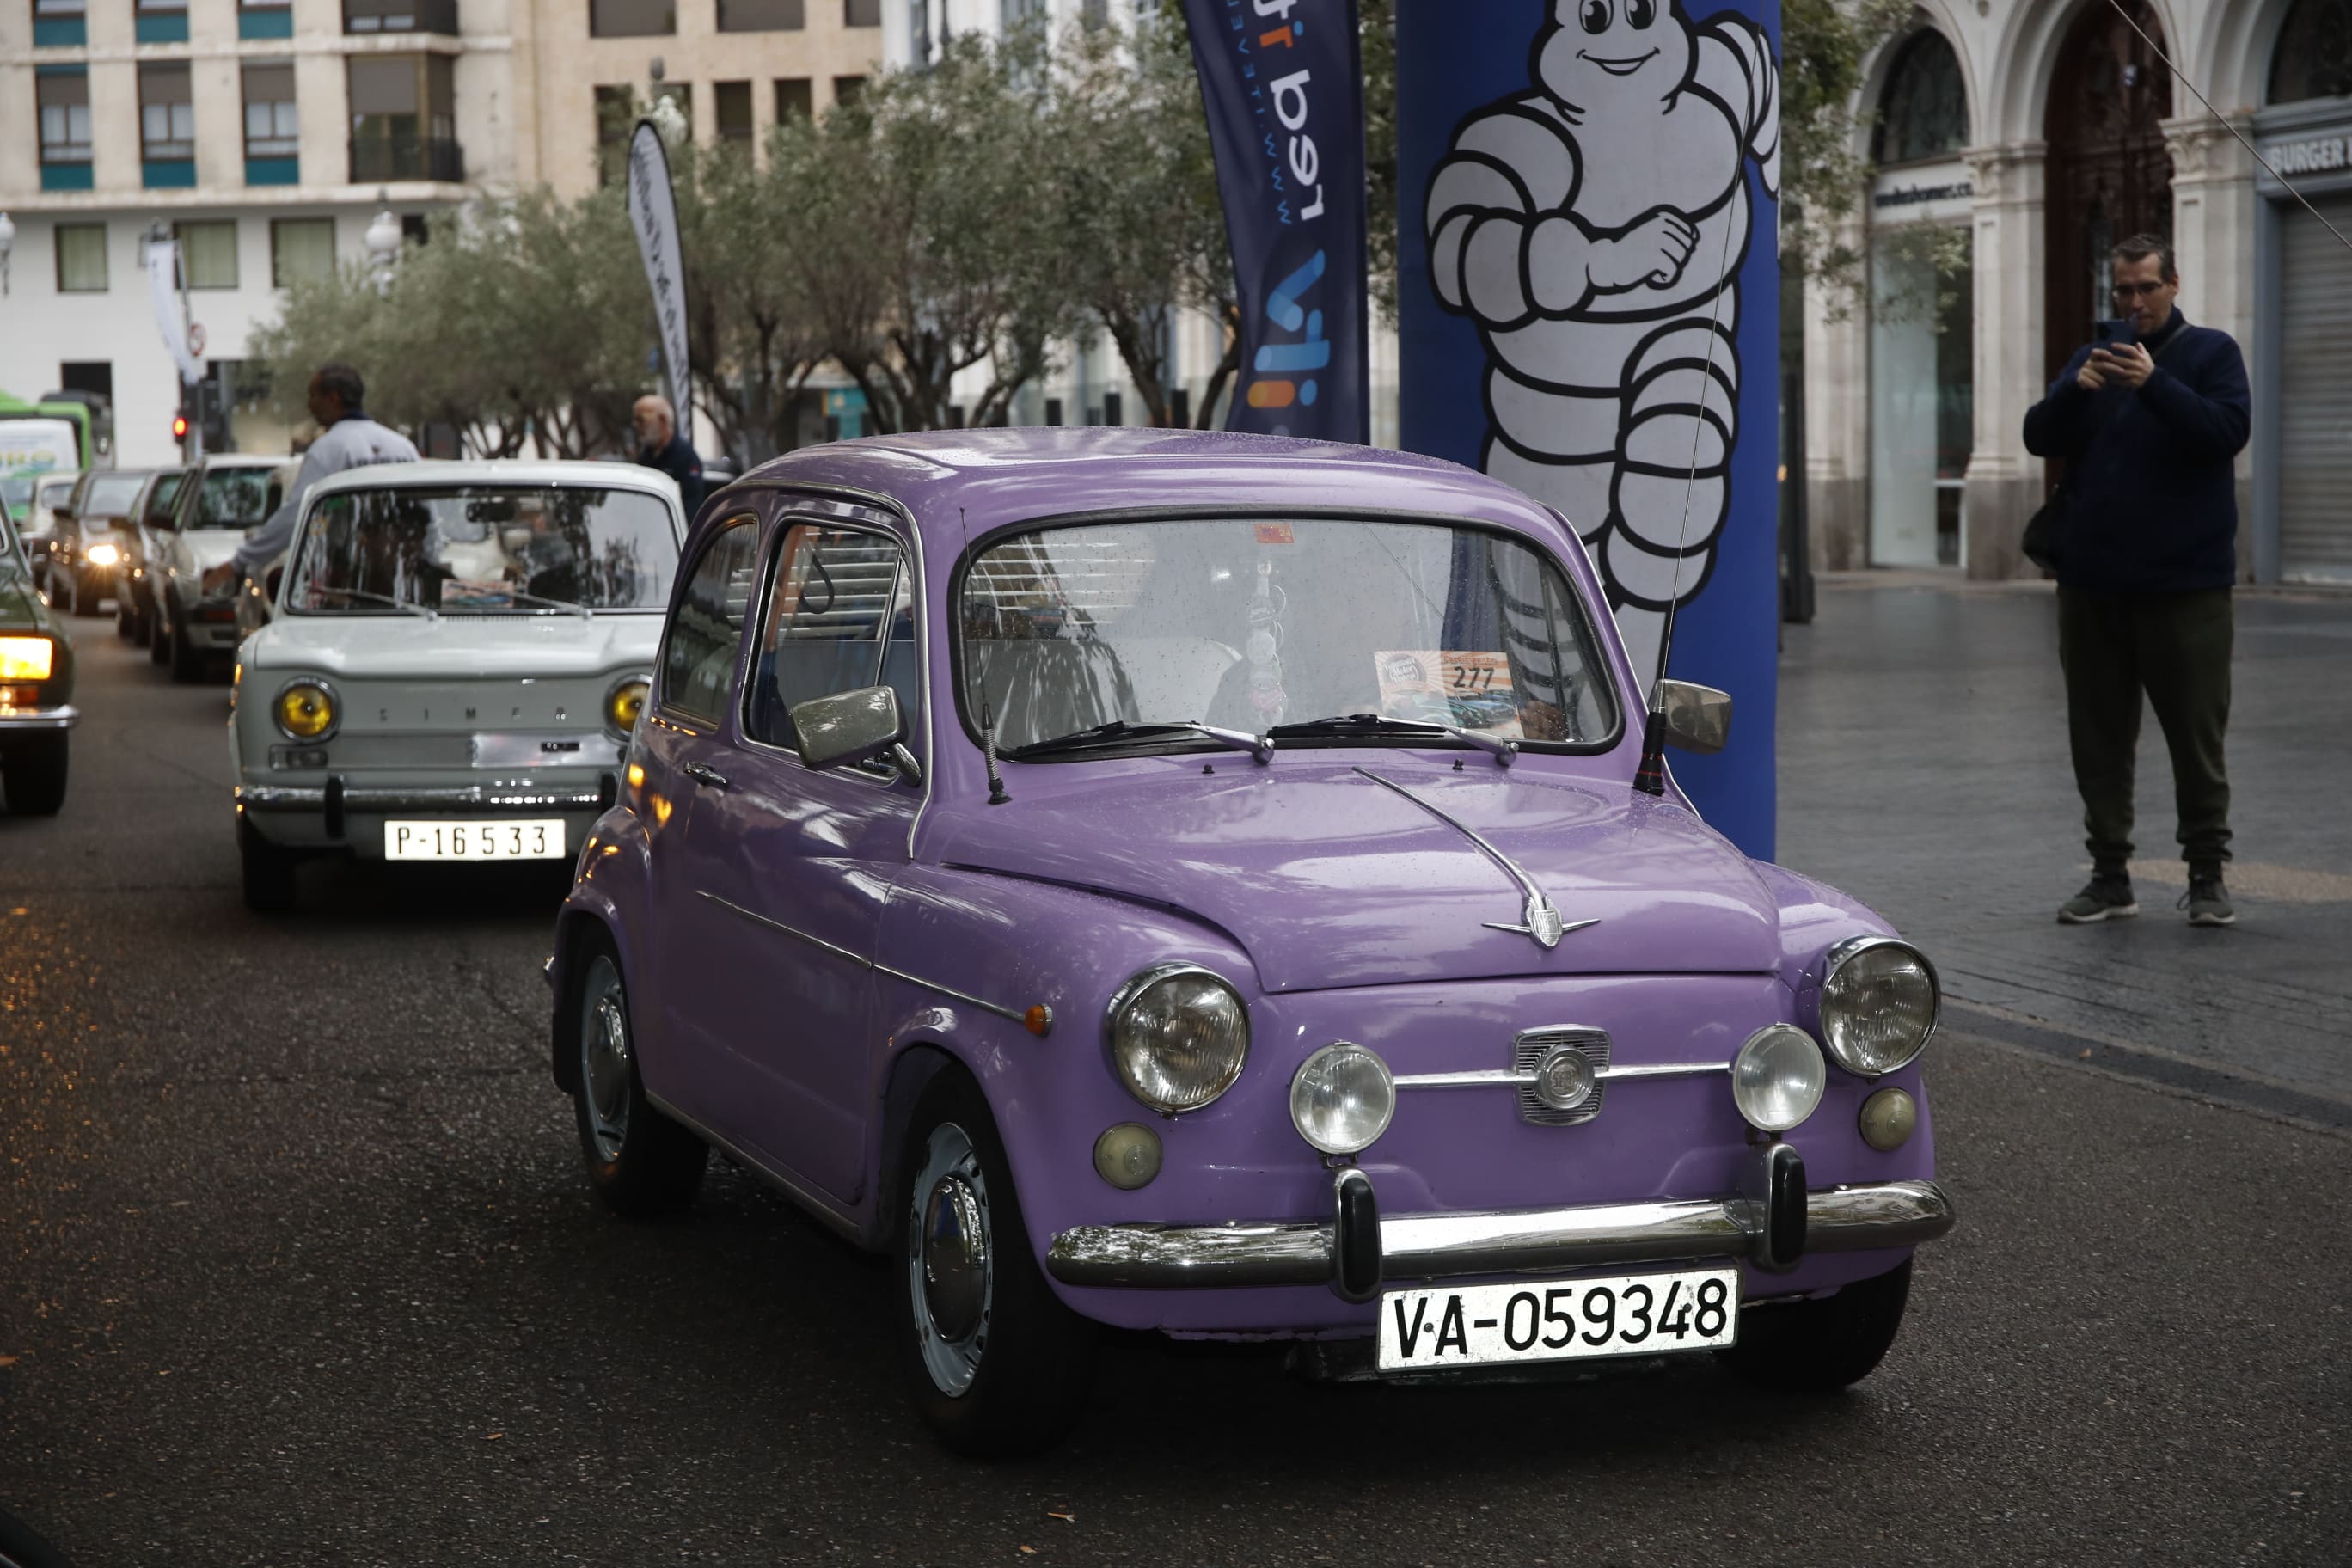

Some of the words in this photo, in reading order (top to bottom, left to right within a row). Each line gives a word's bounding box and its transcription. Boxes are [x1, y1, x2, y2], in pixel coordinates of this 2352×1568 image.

[2269, 138, 2345, 175] BURGER
[1453, 666, 1494, 689] 277
[1394, 1278, 1728, 1358] VA-059348
